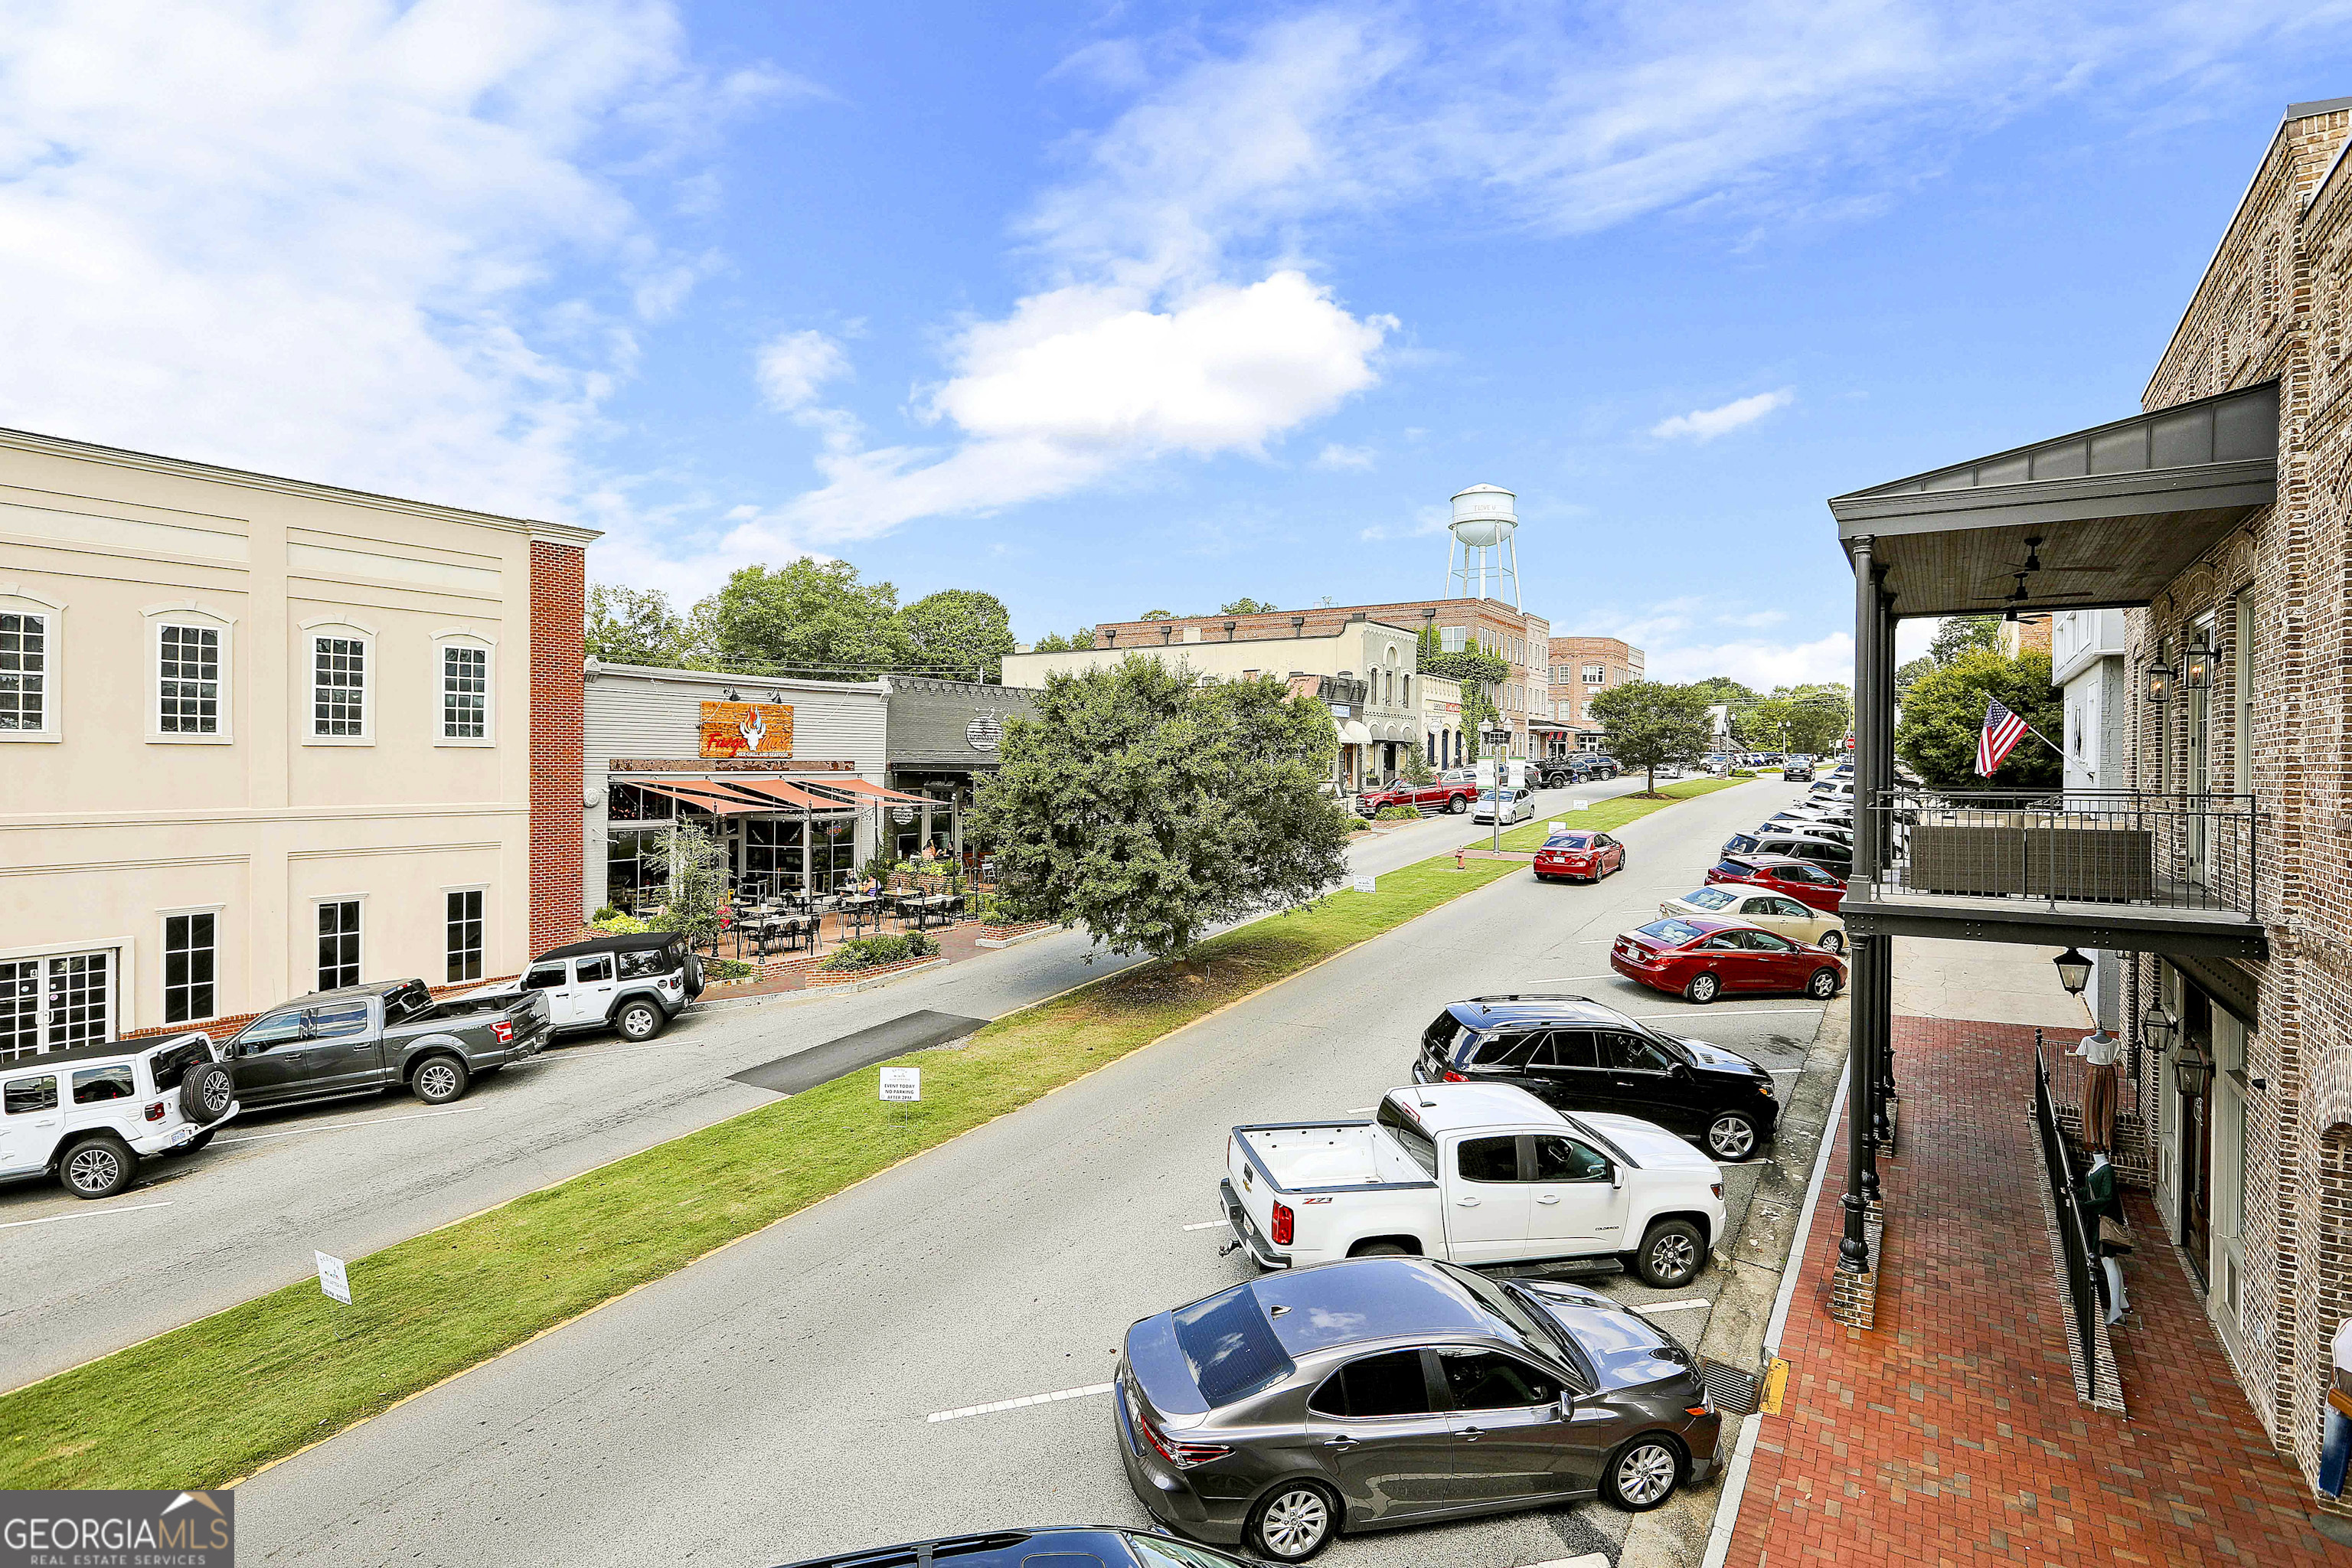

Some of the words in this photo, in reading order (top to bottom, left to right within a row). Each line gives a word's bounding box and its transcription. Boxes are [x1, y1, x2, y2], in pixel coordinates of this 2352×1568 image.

[707, 733, 747, 756] Fuego
[451, 1024, 486, 1033] SPORT
[1302, 1197, 1334, 1205] Z71
